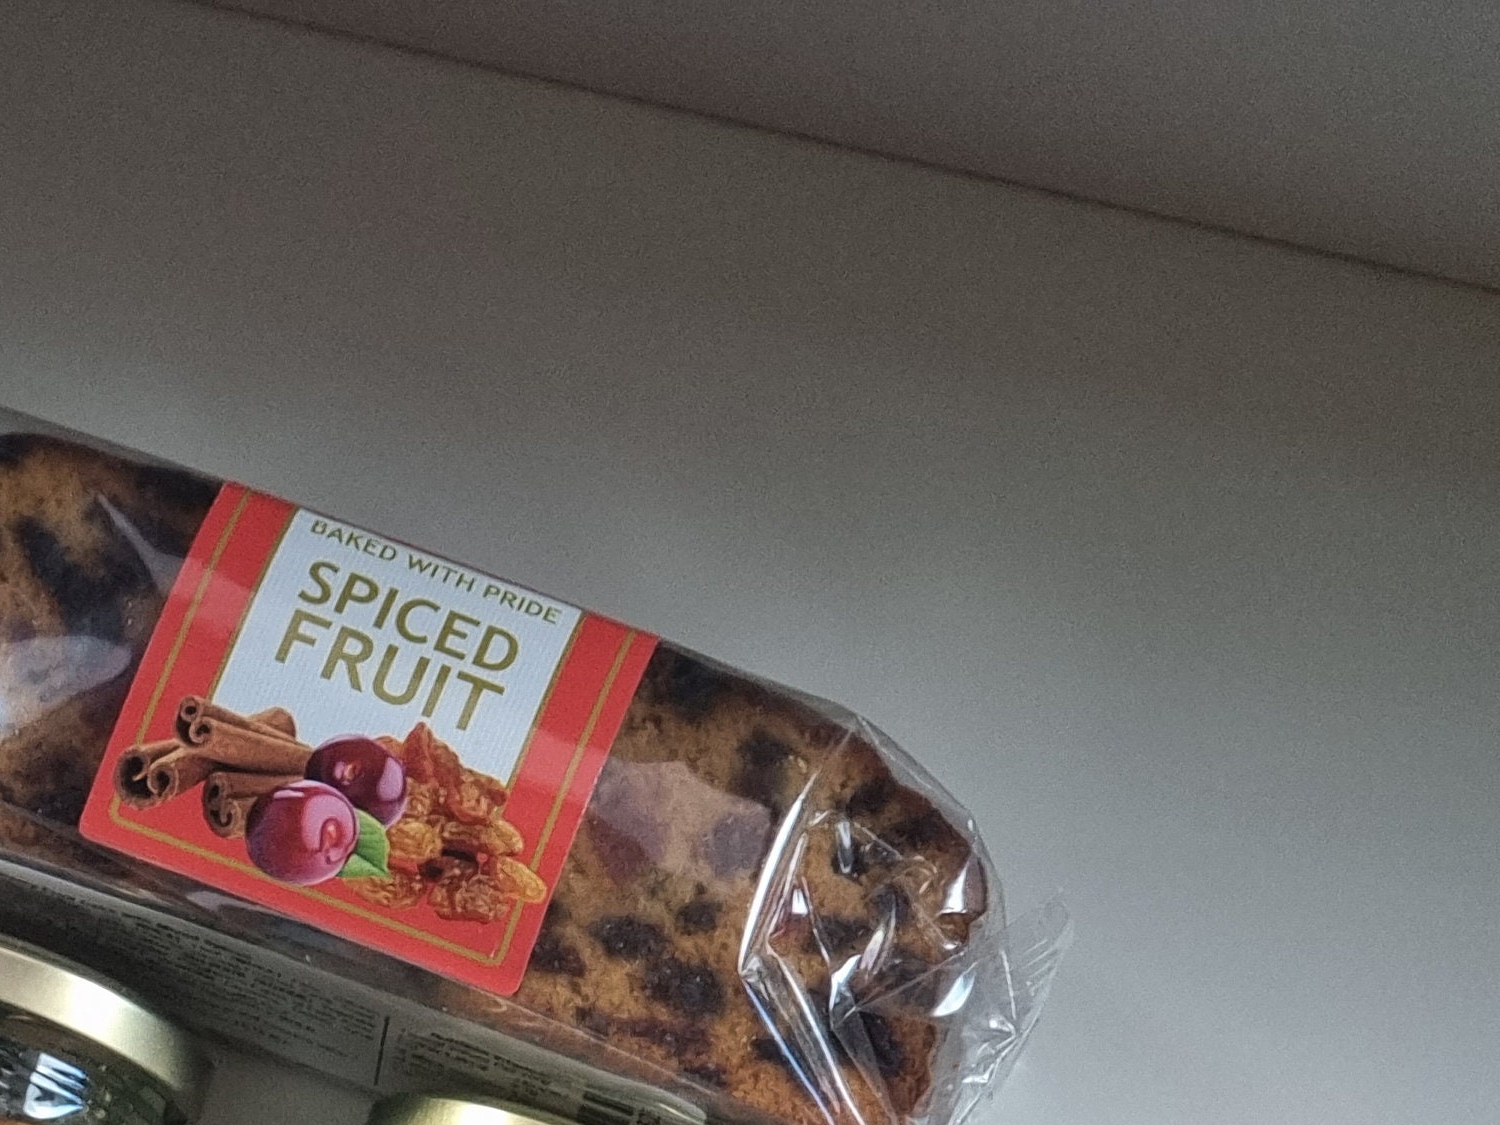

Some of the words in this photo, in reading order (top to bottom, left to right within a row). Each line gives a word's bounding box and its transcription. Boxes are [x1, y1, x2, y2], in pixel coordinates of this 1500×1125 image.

[297, 561, 520, 672] SPICED
[309, 519, 397, 562] BAKED
[408, 553, 476, 593] WITH
[483, 583, 561, 625] PRIDE
[274, 608, 505, 731] FRUIT
